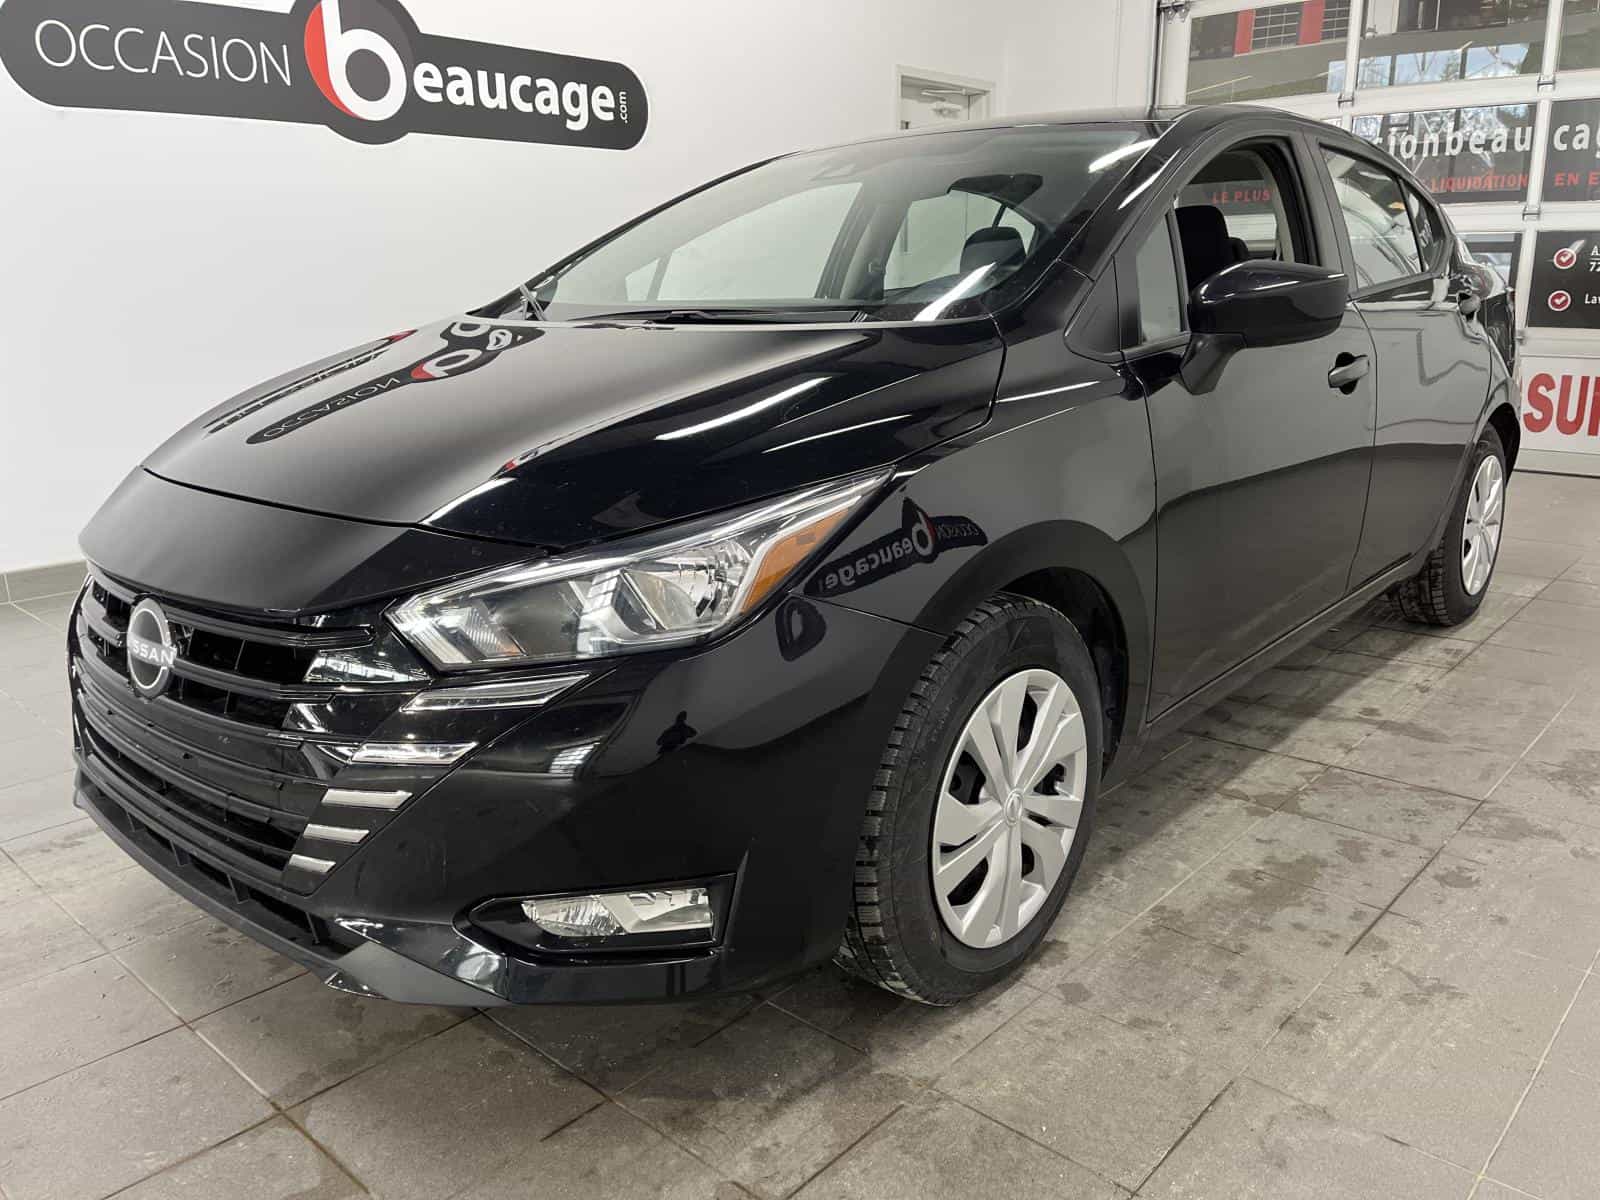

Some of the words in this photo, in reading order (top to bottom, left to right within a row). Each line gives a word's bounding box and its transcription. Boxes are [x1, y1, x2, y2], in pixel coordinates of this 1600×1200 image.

[35, 18, 291, 87] OCCASION
[1553, 123, 1600, 159] ca
[1554, 172, 1579, 187] EN
